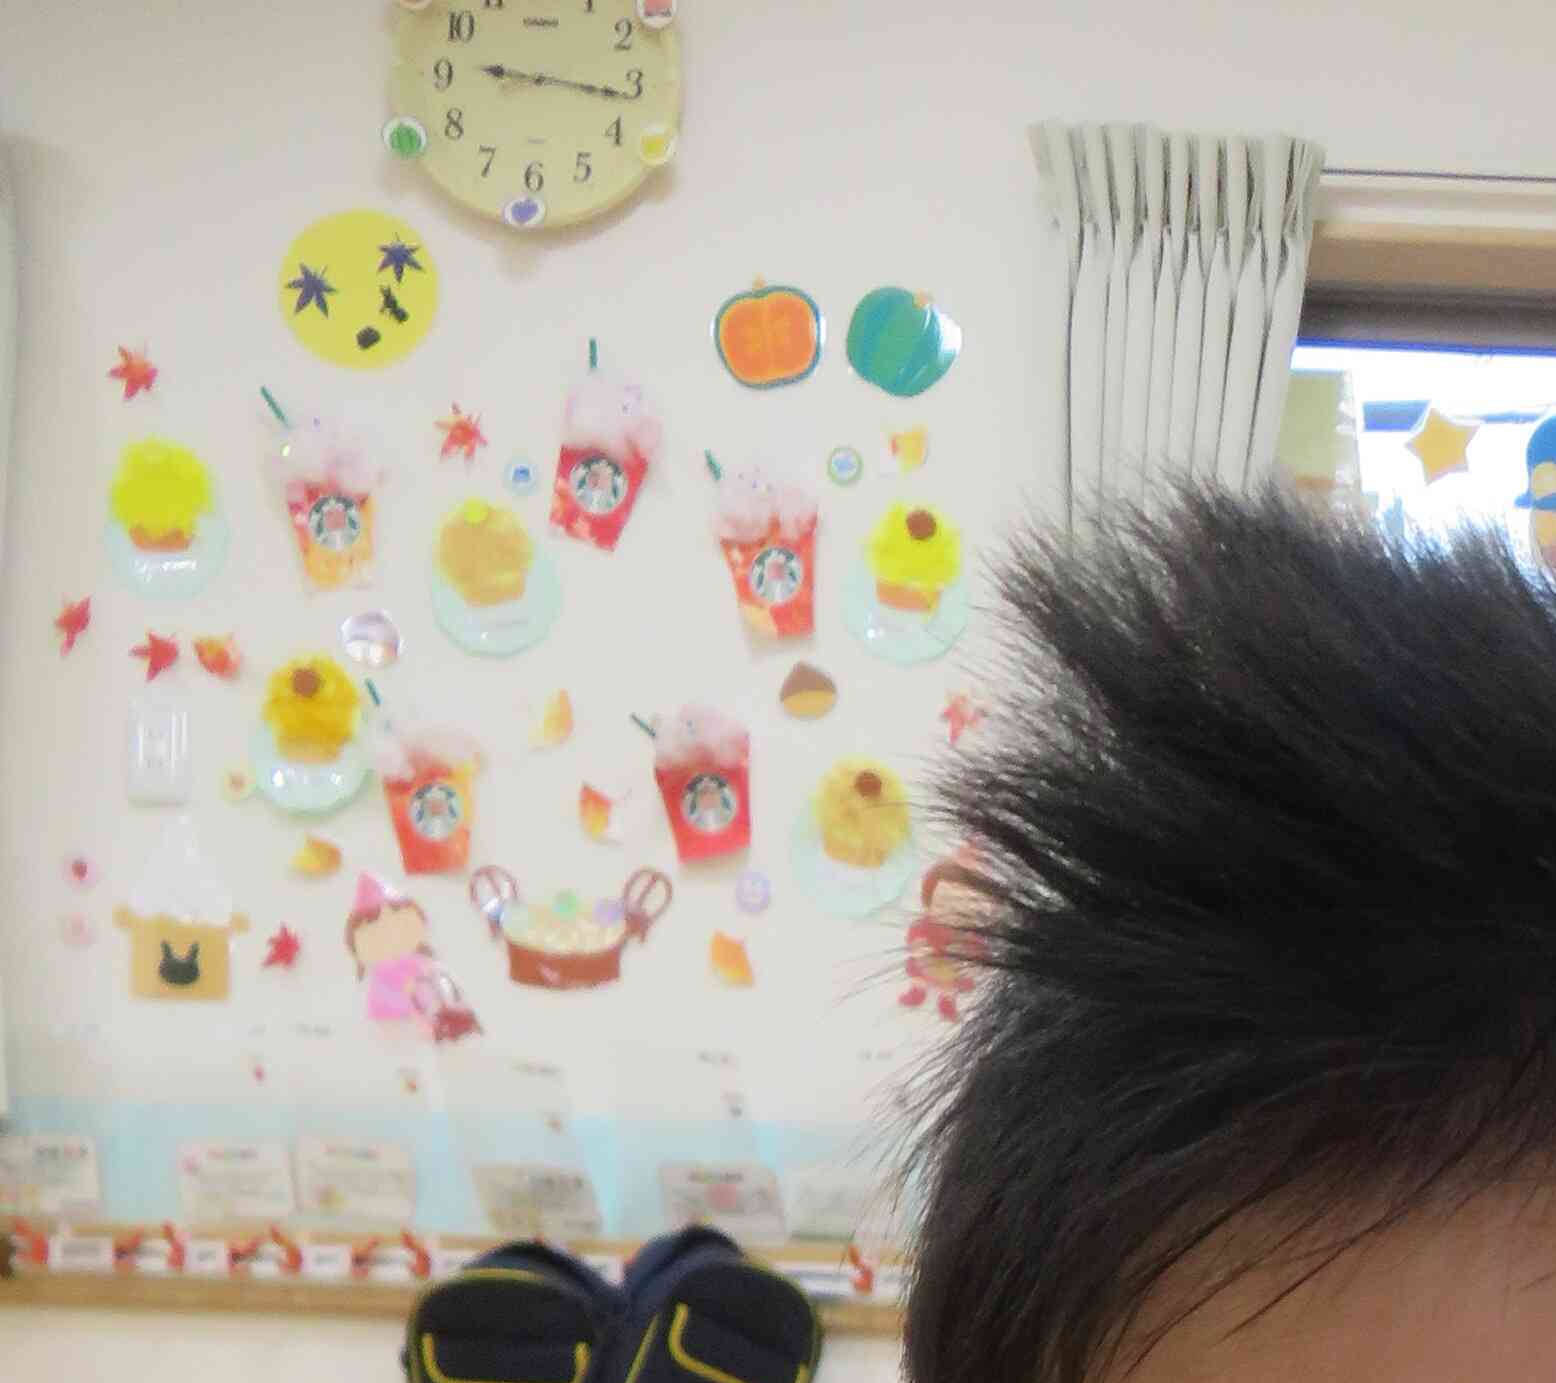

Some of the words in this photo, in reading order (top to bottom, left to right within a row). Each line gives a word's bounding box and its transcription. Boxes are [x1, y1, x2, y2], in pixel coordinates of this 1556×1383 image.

[449, 10, 475, 43] 10
[614, 18, 633, 50] 2
[433, 58, 453, 91] 9
[625, 69, 643, 99] 3
[444, 108, 464, 140] 8
[604, 115, 623, 147] 4
[479, 145, 497, 178] 7
[524, 160, 544, 192] 6
[574, 152, 592, 183] 5
